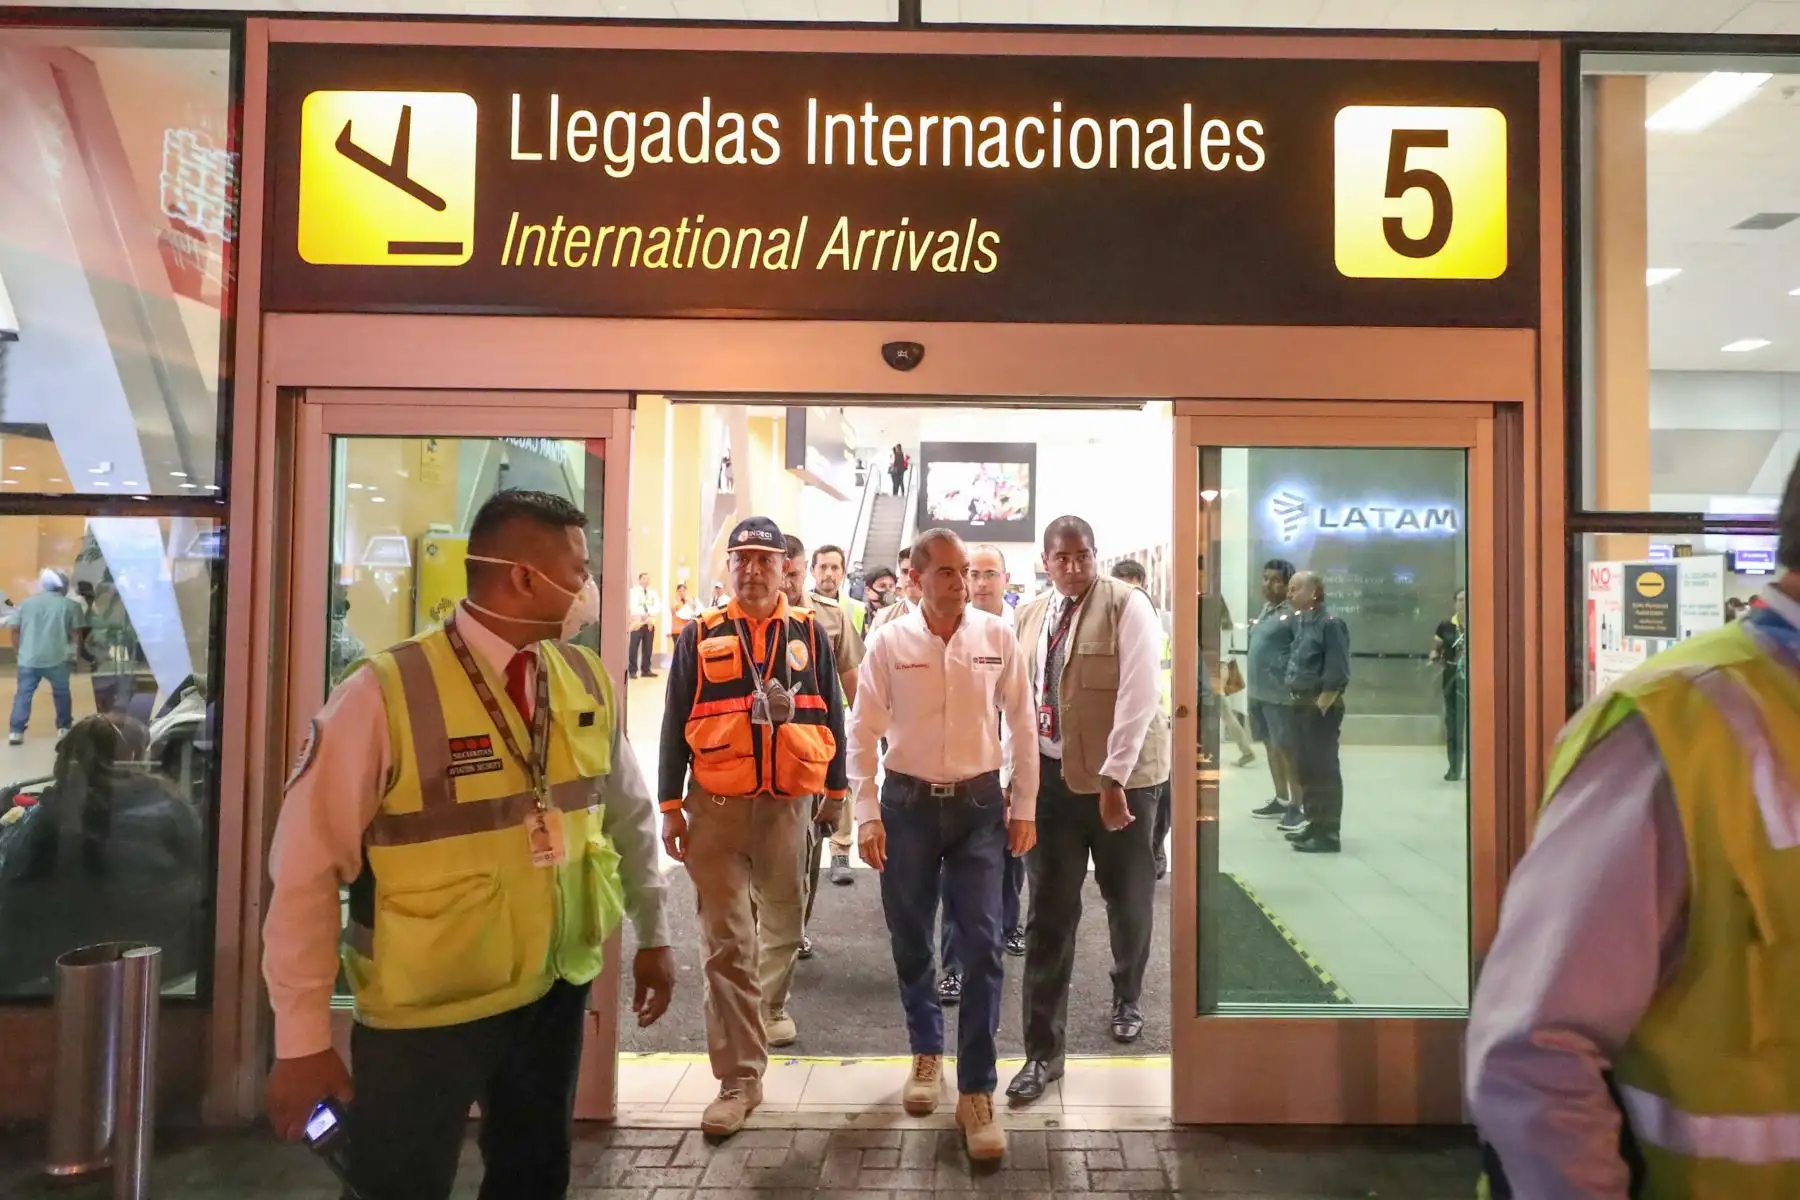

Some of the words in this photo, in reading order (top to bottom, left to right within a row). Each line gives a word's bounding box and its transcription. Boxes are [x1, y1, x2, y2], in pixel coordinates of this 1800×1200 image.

[510, 92, 781, 179] Llegadas
[806, 97, 1266, 172] Internacionales
[1383, 130, 1452, 258] 5
[501, 212, 807, 272] International
[816, 217, 1001, 274] Arrivals
[1319, 506, 1458, 530] LATAM
[1590, 567, 1612, 585] NO
[452, 748, 492, 758] SECURITAS
